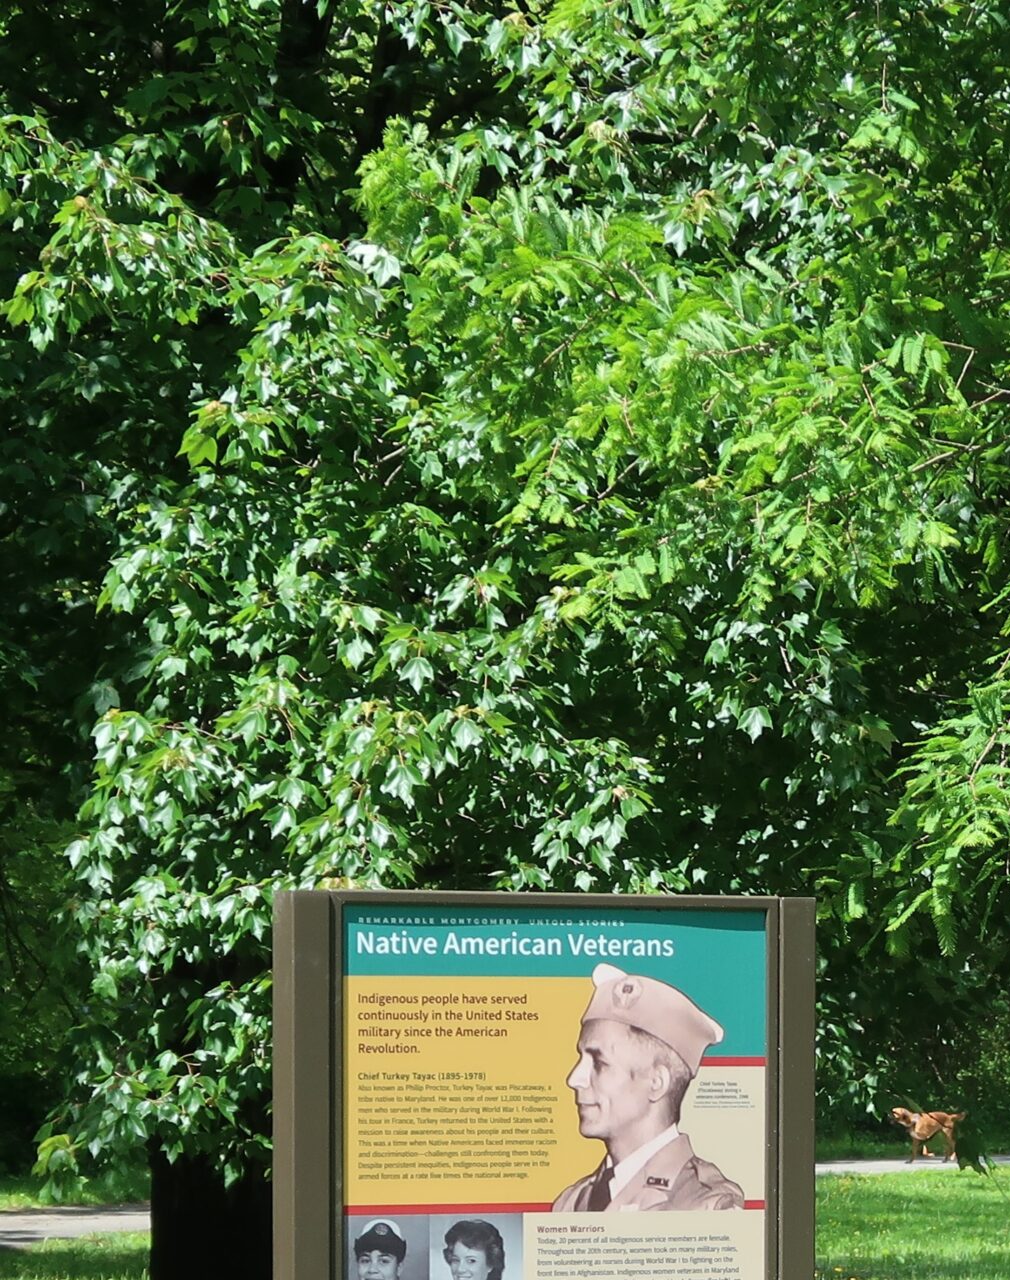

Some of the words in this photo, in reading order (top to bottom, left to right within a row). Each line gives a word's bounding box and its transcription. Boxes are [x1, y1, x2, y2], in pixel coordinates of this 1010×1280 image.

[356, 932, 436, 955] Native
[444, 932, 561, 955] American
[568, 933, 674, 956] Veterans
[358, 993, 418, 1007] Indigenous
[421, 993, 458, 1007] people
[462, 993, 487, 1004] have
[490, 993, 528, 1004] served
[358, 1010, 428, 1023] continuously
[431, 1010, 441, 1021] in
[444, 1010, 462, 1021] the
[465, 1010, 501, 1021] United
[505, 1010, 539, 1021] States
[358, 1026, 400, 1040] military
[403, 1026, 431, 1037] since
[435, 1026, 452, 1037] the
[455, 1026, 508, 1037] American
[358, 1043, 420, 1054] Revolution.
[358, 1072, 379, 1080] Chief
[382, 1072, 409, 1082] Turkey
[412, 1072, 435, 1081] Tayac
[438, 1072, 486, 1081] (1895-1978)
[537, 1225, 567, 1233] Women
[570, 1225, 605, 1233] Warriors
